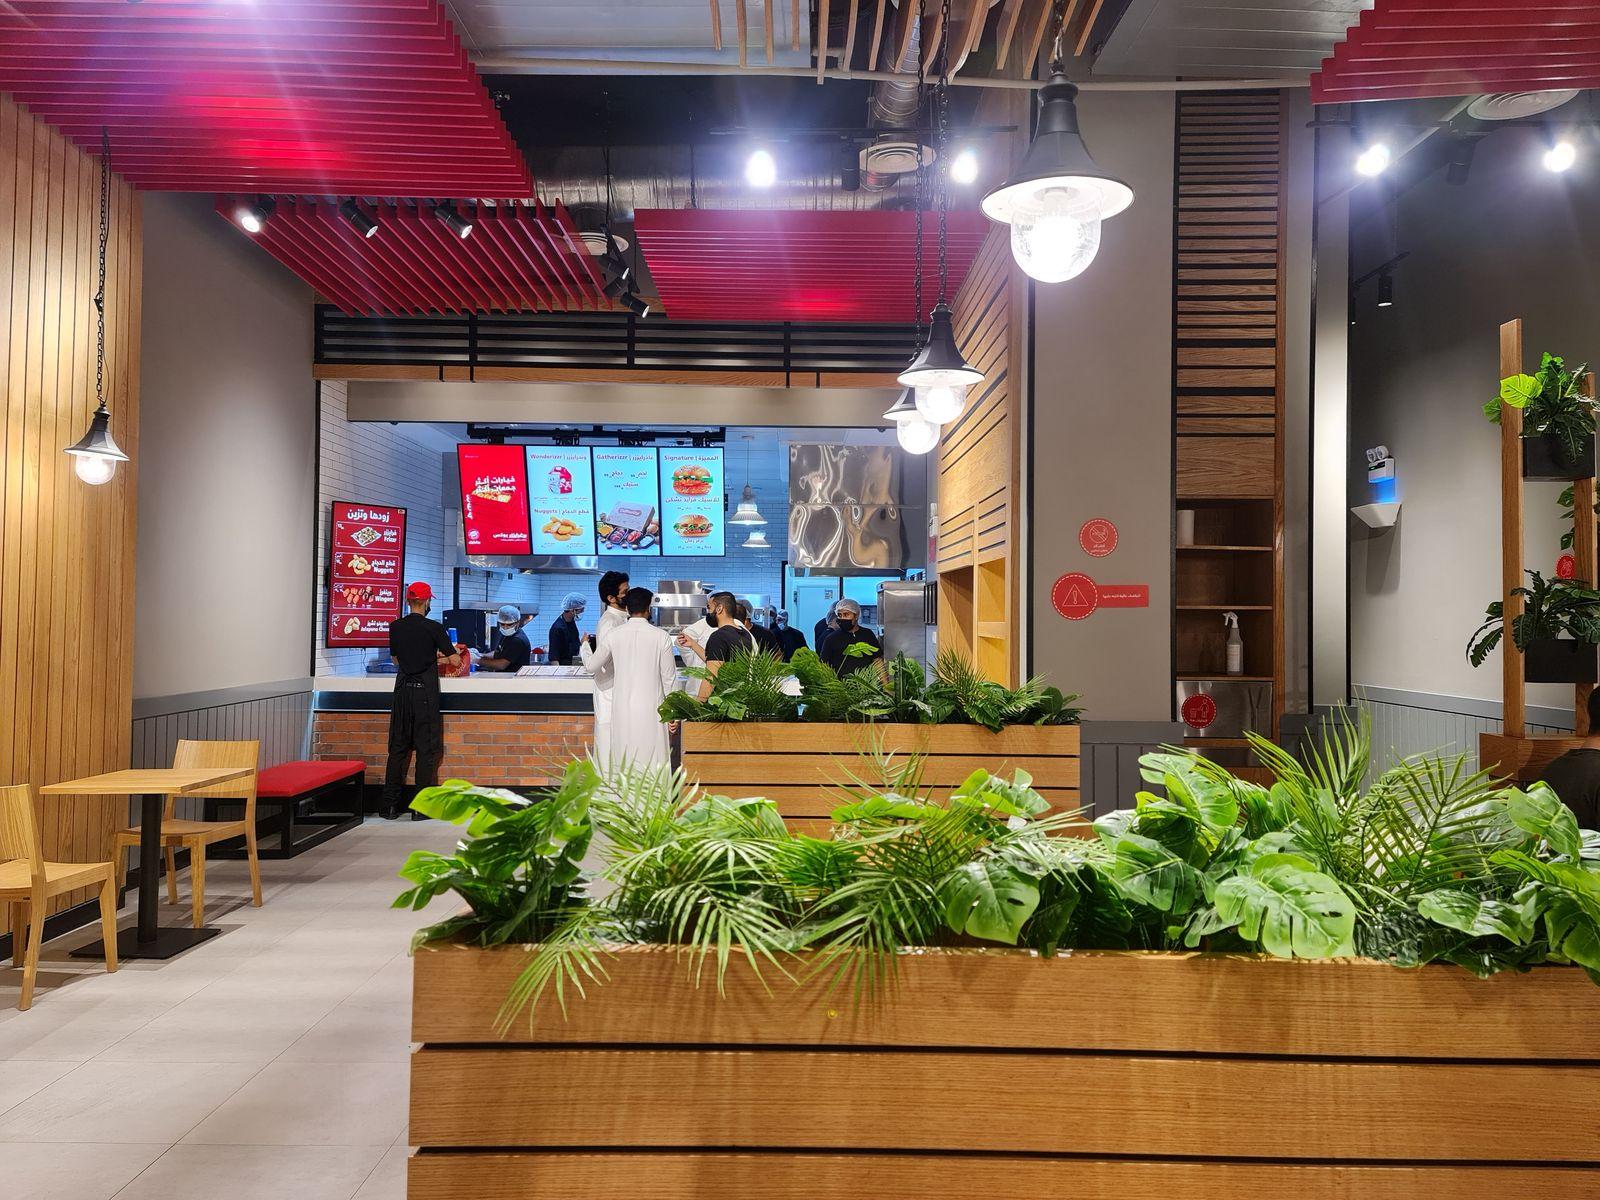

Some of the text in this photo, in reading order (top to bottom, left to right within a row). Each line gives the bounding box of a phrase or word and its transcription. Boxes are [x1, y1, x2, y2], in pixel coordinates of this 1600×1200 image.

[491, 475, 516, 484] خيارات
[347, 508, 368, 520] وتزين
[369, 510, 390, 522] زودها
